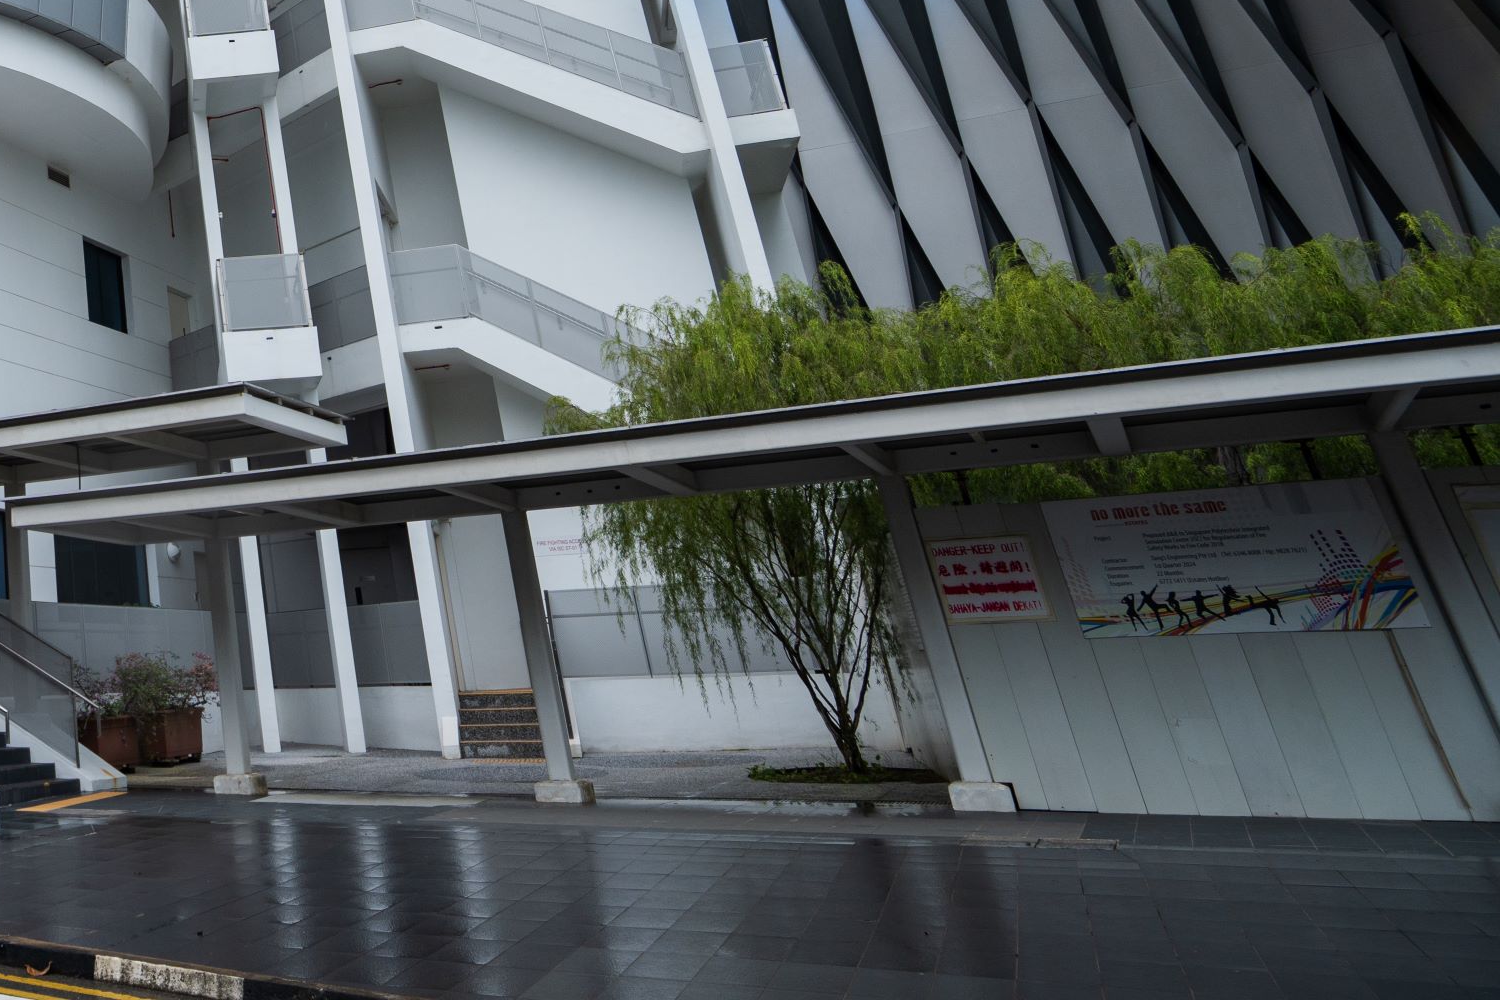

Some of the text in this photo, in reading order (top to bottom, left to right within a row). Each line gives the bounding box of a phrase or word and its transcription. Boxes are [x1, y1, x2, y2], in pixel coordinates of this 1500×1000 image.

[1090, 500, 1226, 521] no more the same
[932, 542, 1024, 557] DANGER-KEEP OUT!
